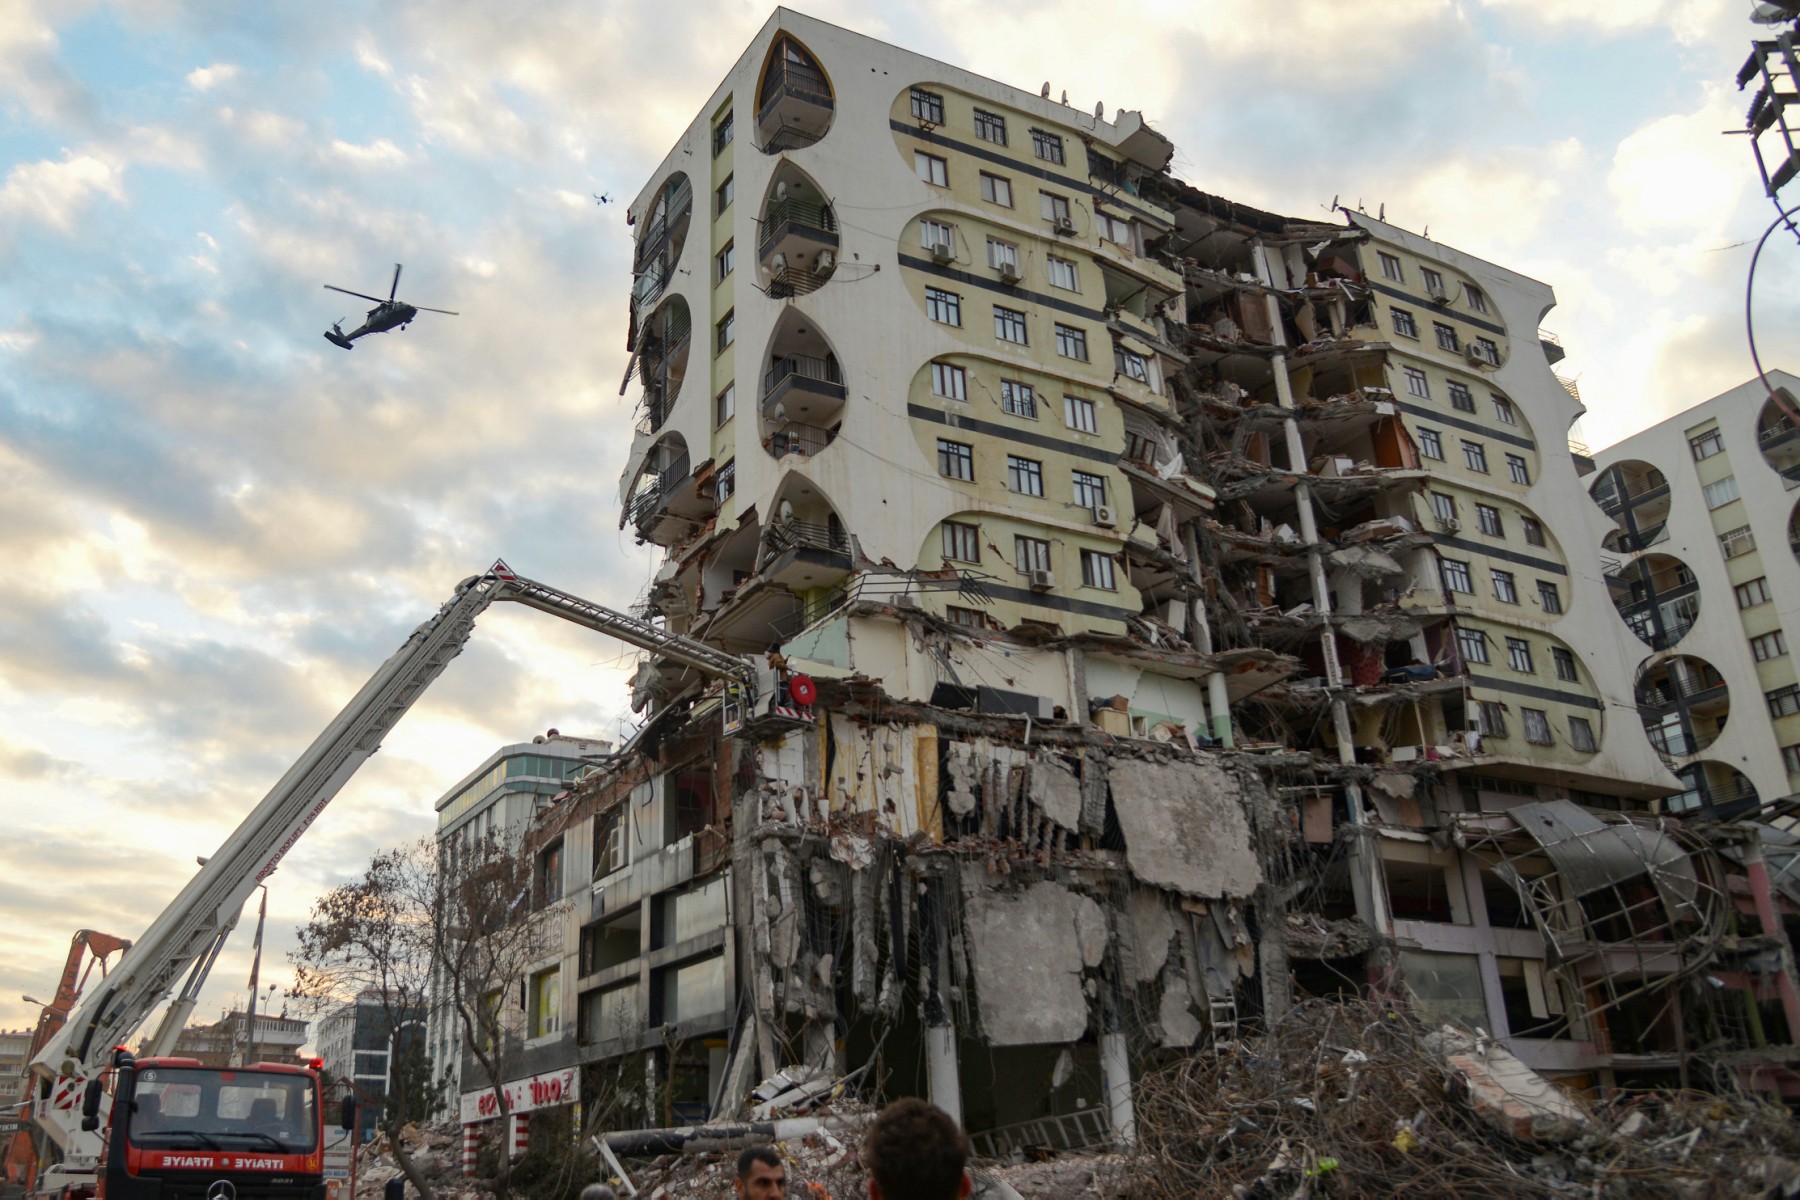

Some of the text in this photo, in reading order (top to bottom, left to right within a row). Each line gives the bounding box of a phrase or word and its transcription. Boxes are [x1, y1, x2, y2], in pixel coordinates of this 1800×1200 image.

[255, 853, 281, 882] BRONTO
[279, 826, 302, 854] SKYLIFT
[314, 797, 328, 813] HDT
